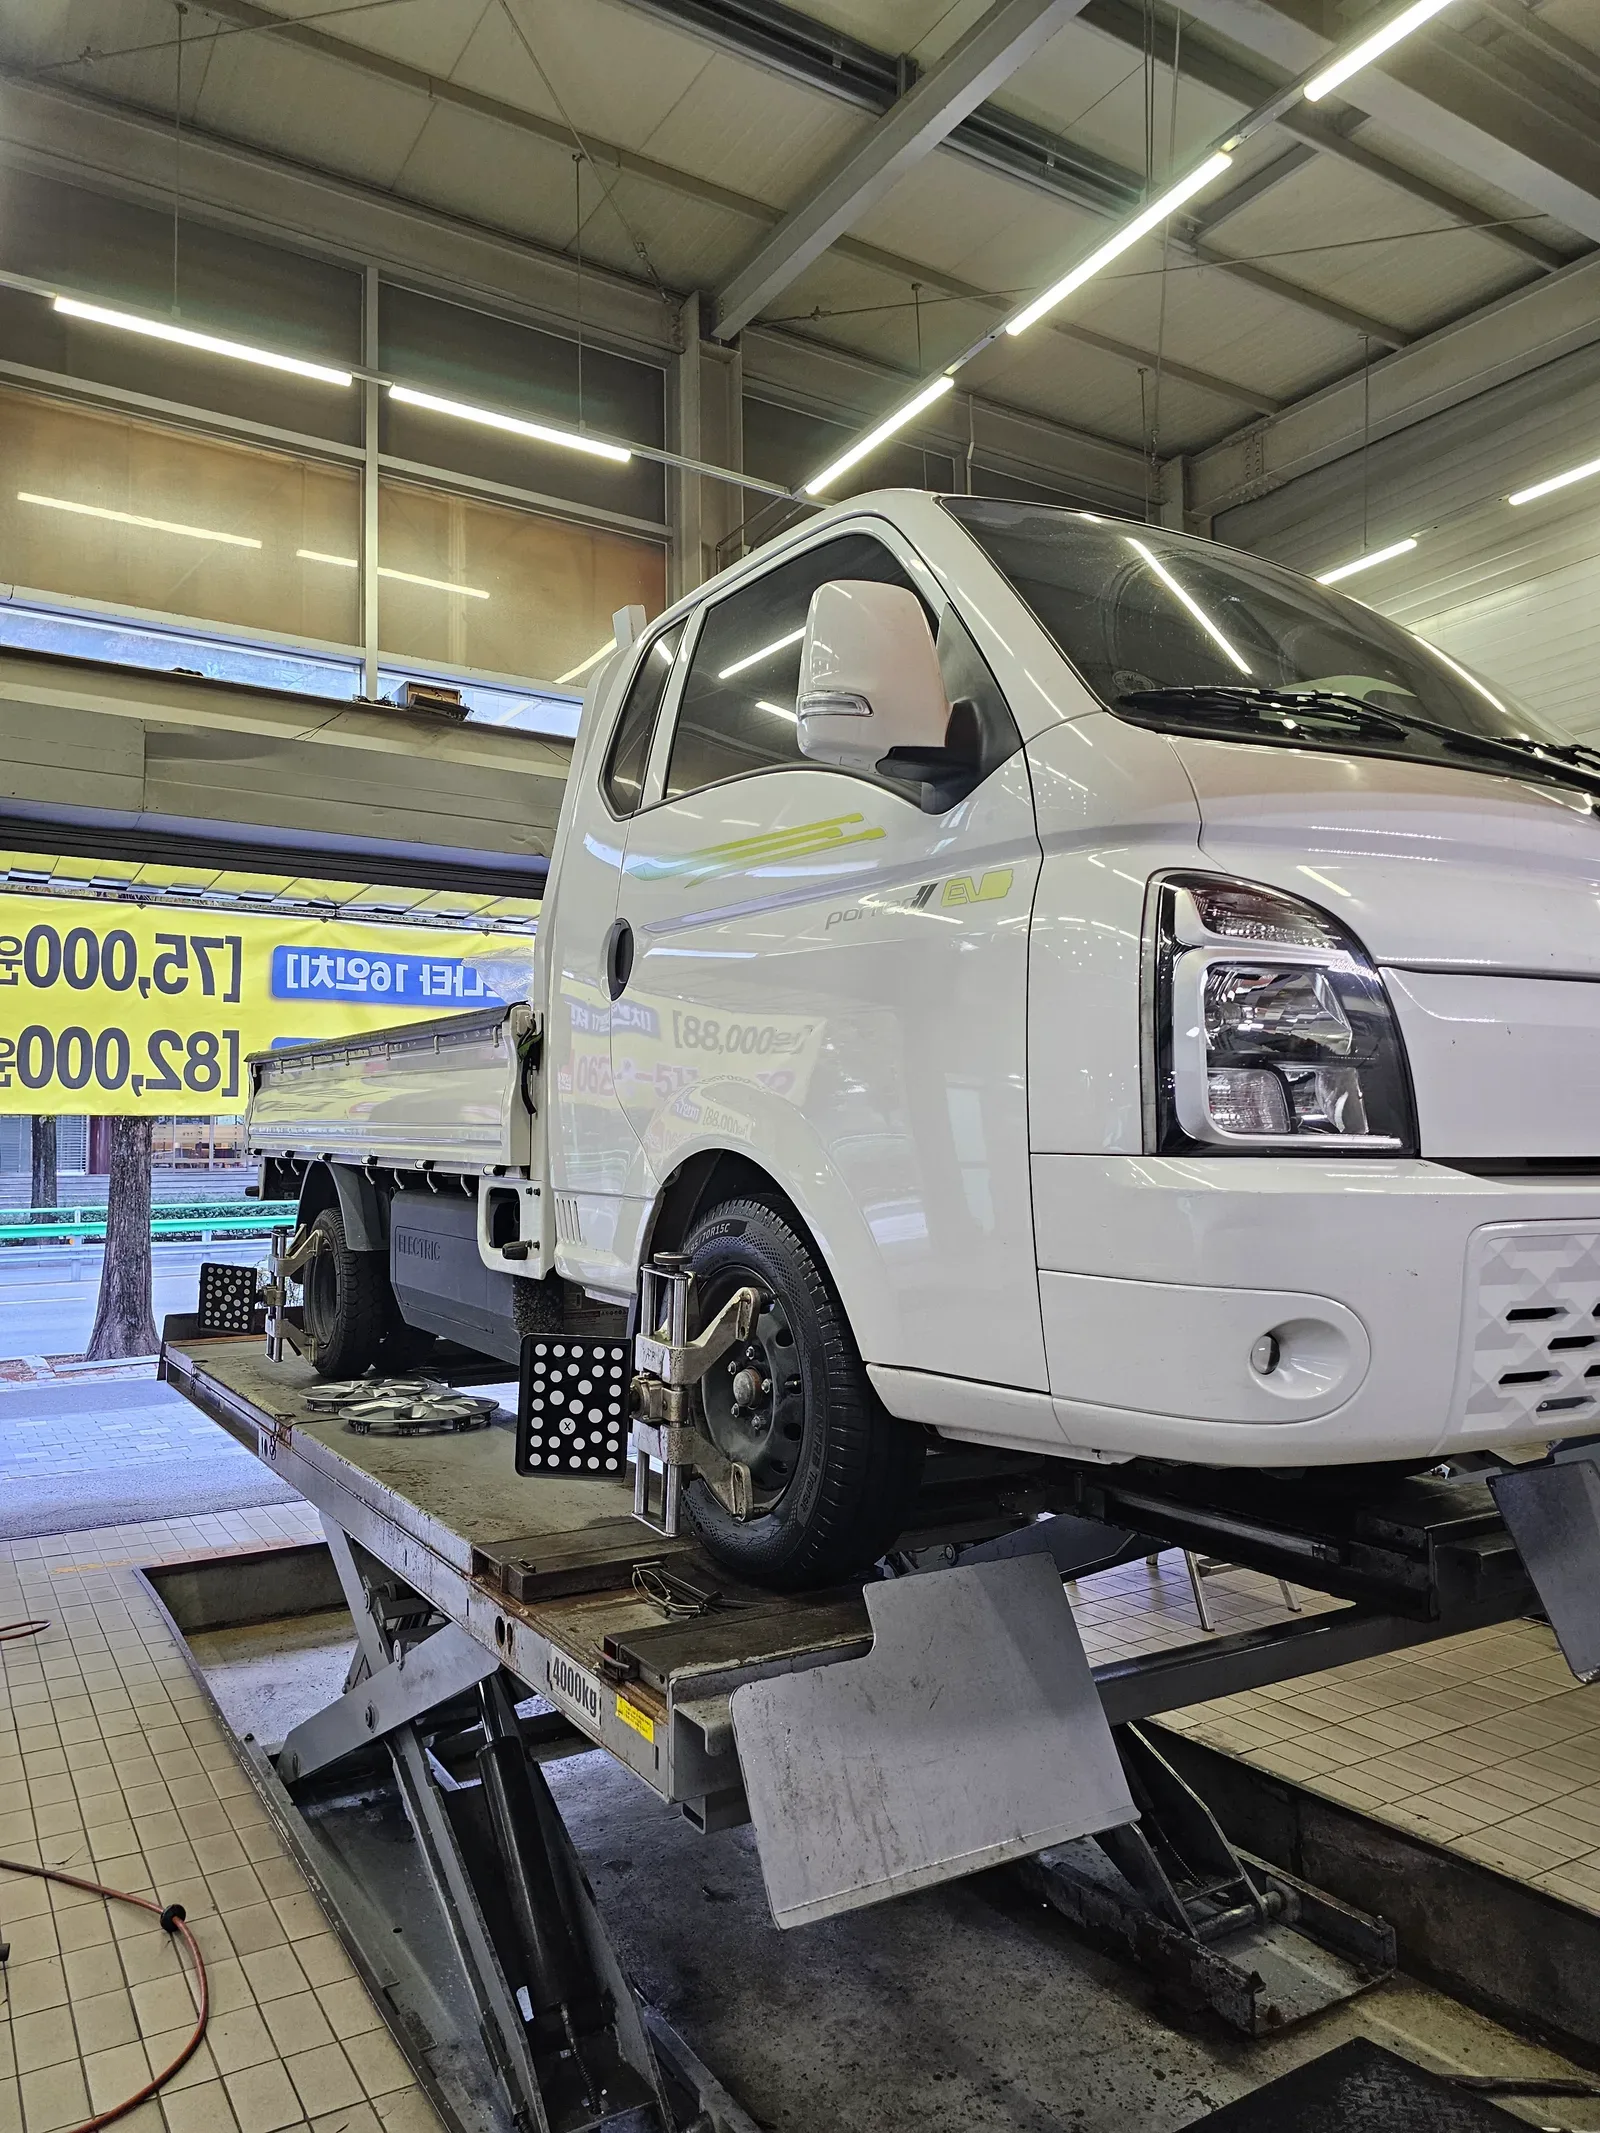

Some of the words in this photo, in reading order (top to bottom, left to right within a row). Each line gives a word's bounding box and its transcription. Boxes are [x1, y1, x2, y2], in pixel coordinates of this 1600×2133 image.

[941, 868, 1014, 908] EV
[398, 1234, 441, 1261] ELECTRIC
[552, 1655, 597, 1718] 4000kg
